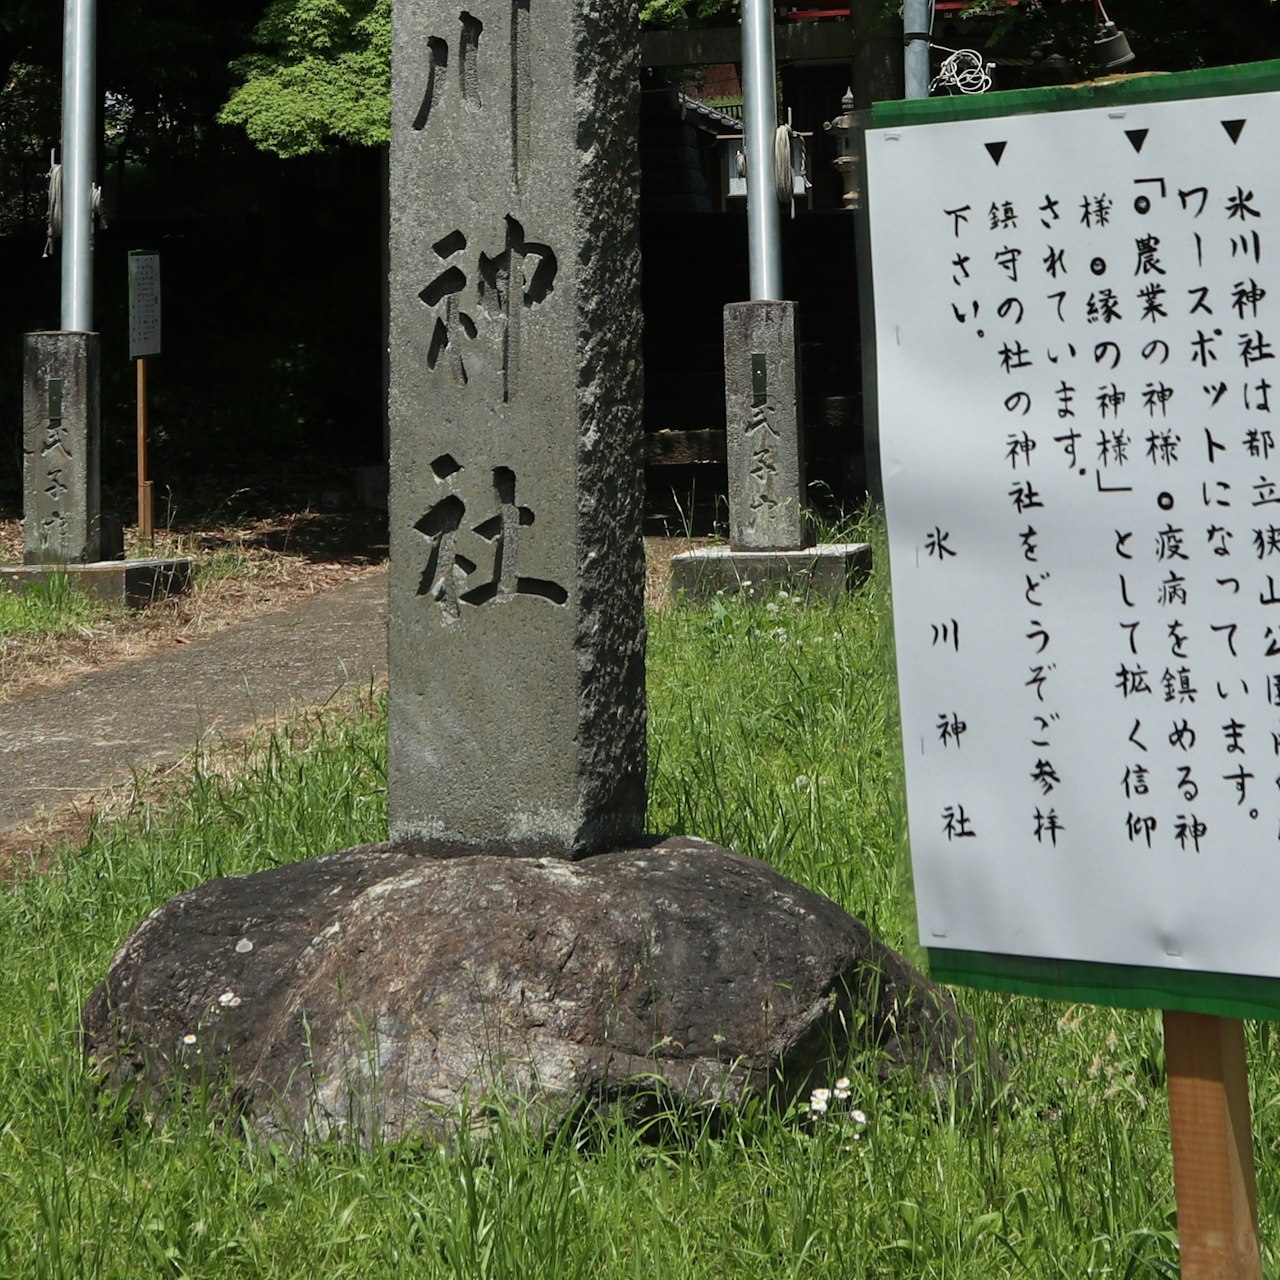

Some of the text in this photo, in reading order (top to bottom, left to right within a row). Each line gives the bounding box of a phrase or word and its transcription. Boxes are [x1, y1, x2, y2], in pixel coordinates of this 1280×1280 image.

[943, 204, 985, 339] 下さい。
[1039, 193, 1087, 477] されています。
[987, 200, 1065, 847] 鎮守の杜の神社をどうぞご参拝
[924, 526, 977, 841] 氷川神社
